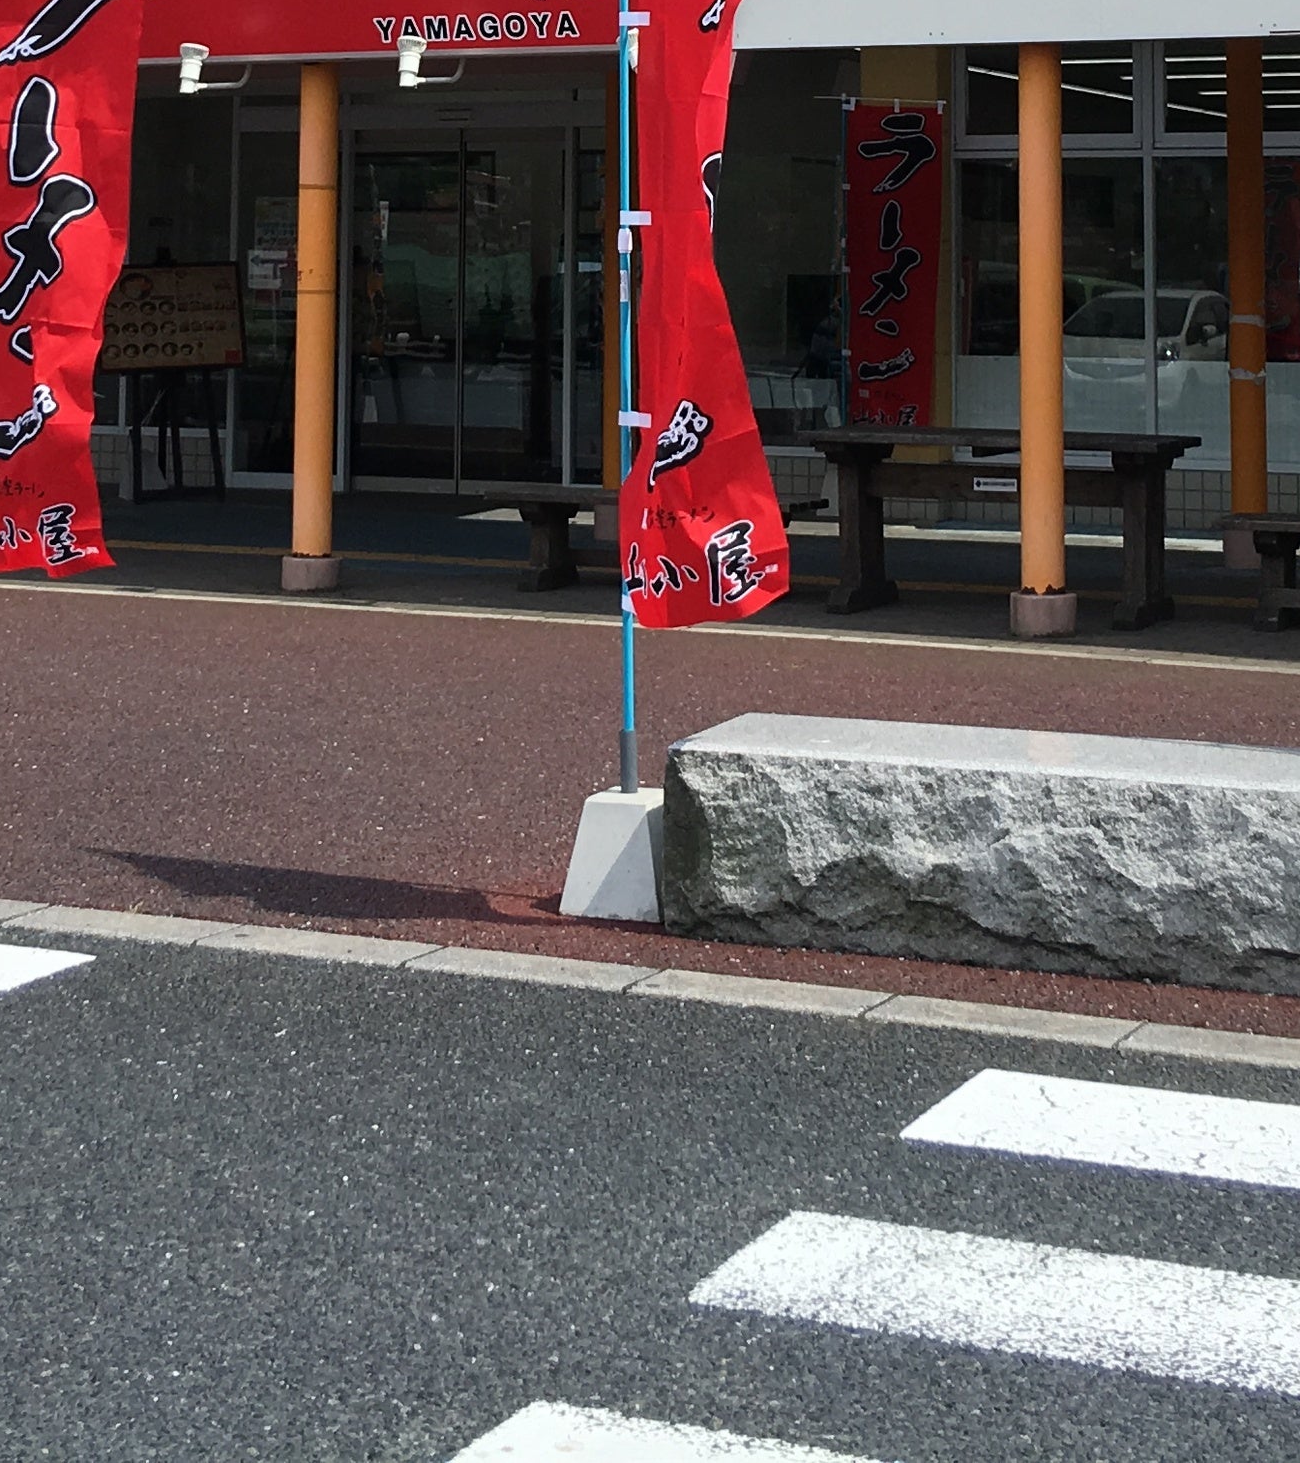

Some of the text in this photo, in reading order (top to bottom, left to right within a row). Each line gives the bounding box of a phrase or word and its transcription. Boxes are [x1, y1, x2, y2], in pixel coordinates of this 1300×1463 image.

[373, 10, 580, 44] YAMAGOYA
[858, 112, 937, 381] ラーメン
[626, 519, 766, 606] 山小屋
